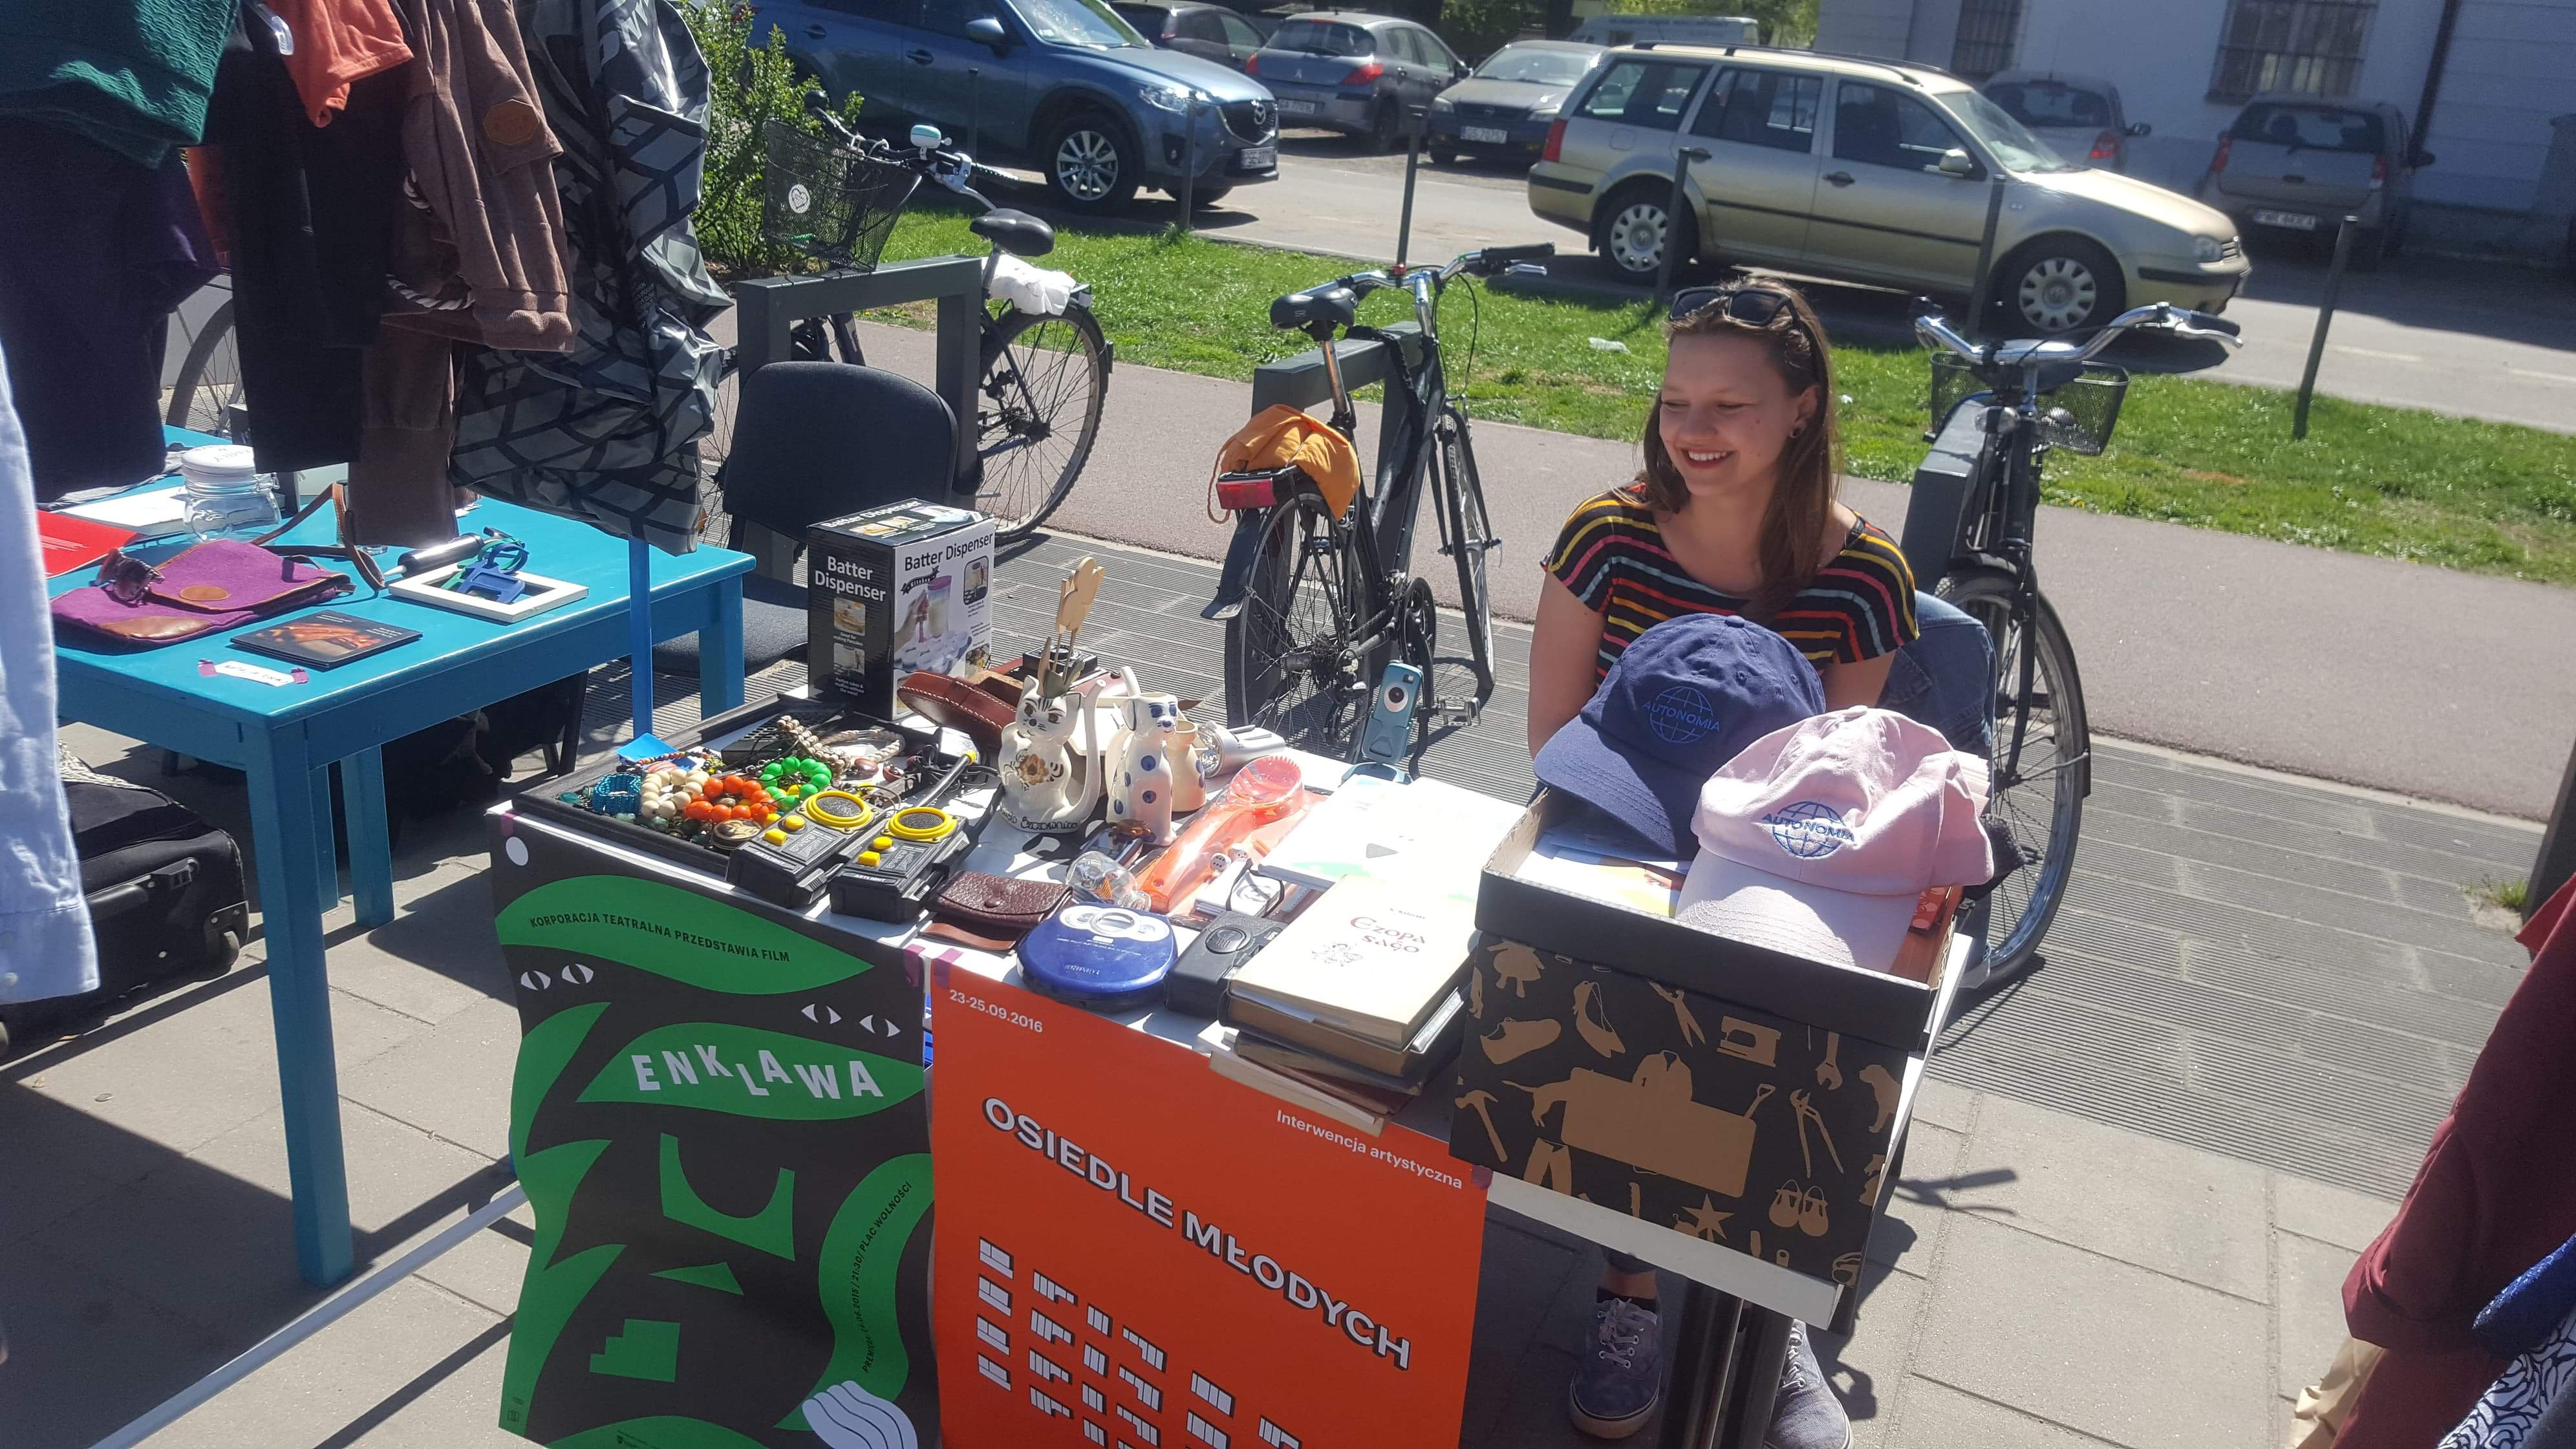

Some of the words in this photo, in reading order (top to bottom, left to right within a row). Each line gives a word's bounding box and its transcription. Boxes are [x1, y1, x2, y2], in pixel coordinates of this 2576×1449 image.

[821, 516, 864, 528] Batter
[860, 501, 922, 518] Dispenser
[828, 555, 873, 581] Batter
[905, 550, 943, 572] Batter
[945, 532, 993, 561] Dispenser
[815, 569, 886, 602] Dispenser
[1642, 700, 1720, 732] AUTONOMIA
[1761, 812, 1854, 841] AUTONOMIA
[530, 912, 600, 928] KORPORACJA
[602, 913, 672, 938] TEATRALNA
[674, 930, 759, 958] PRZEDSTAWIA
[760, 949, 790, 962] FILM
[949, 989, 1044, 1033] 23-25.09.2016
[631, 1045, 884, 1099] ENKLAWA
[1276, 1110, 1366, 1153] Interwencja
[1369, 1146, 1463, 1189] artystyczna
[859, 1227, 877, 1252] PLAC
[874, 1181, 912, 1228] WOLNOŚCI
[983, 1097, 1174, 1229] OSIEDLE
[1182, 1209, 1412, 1371] MŁODYCH
